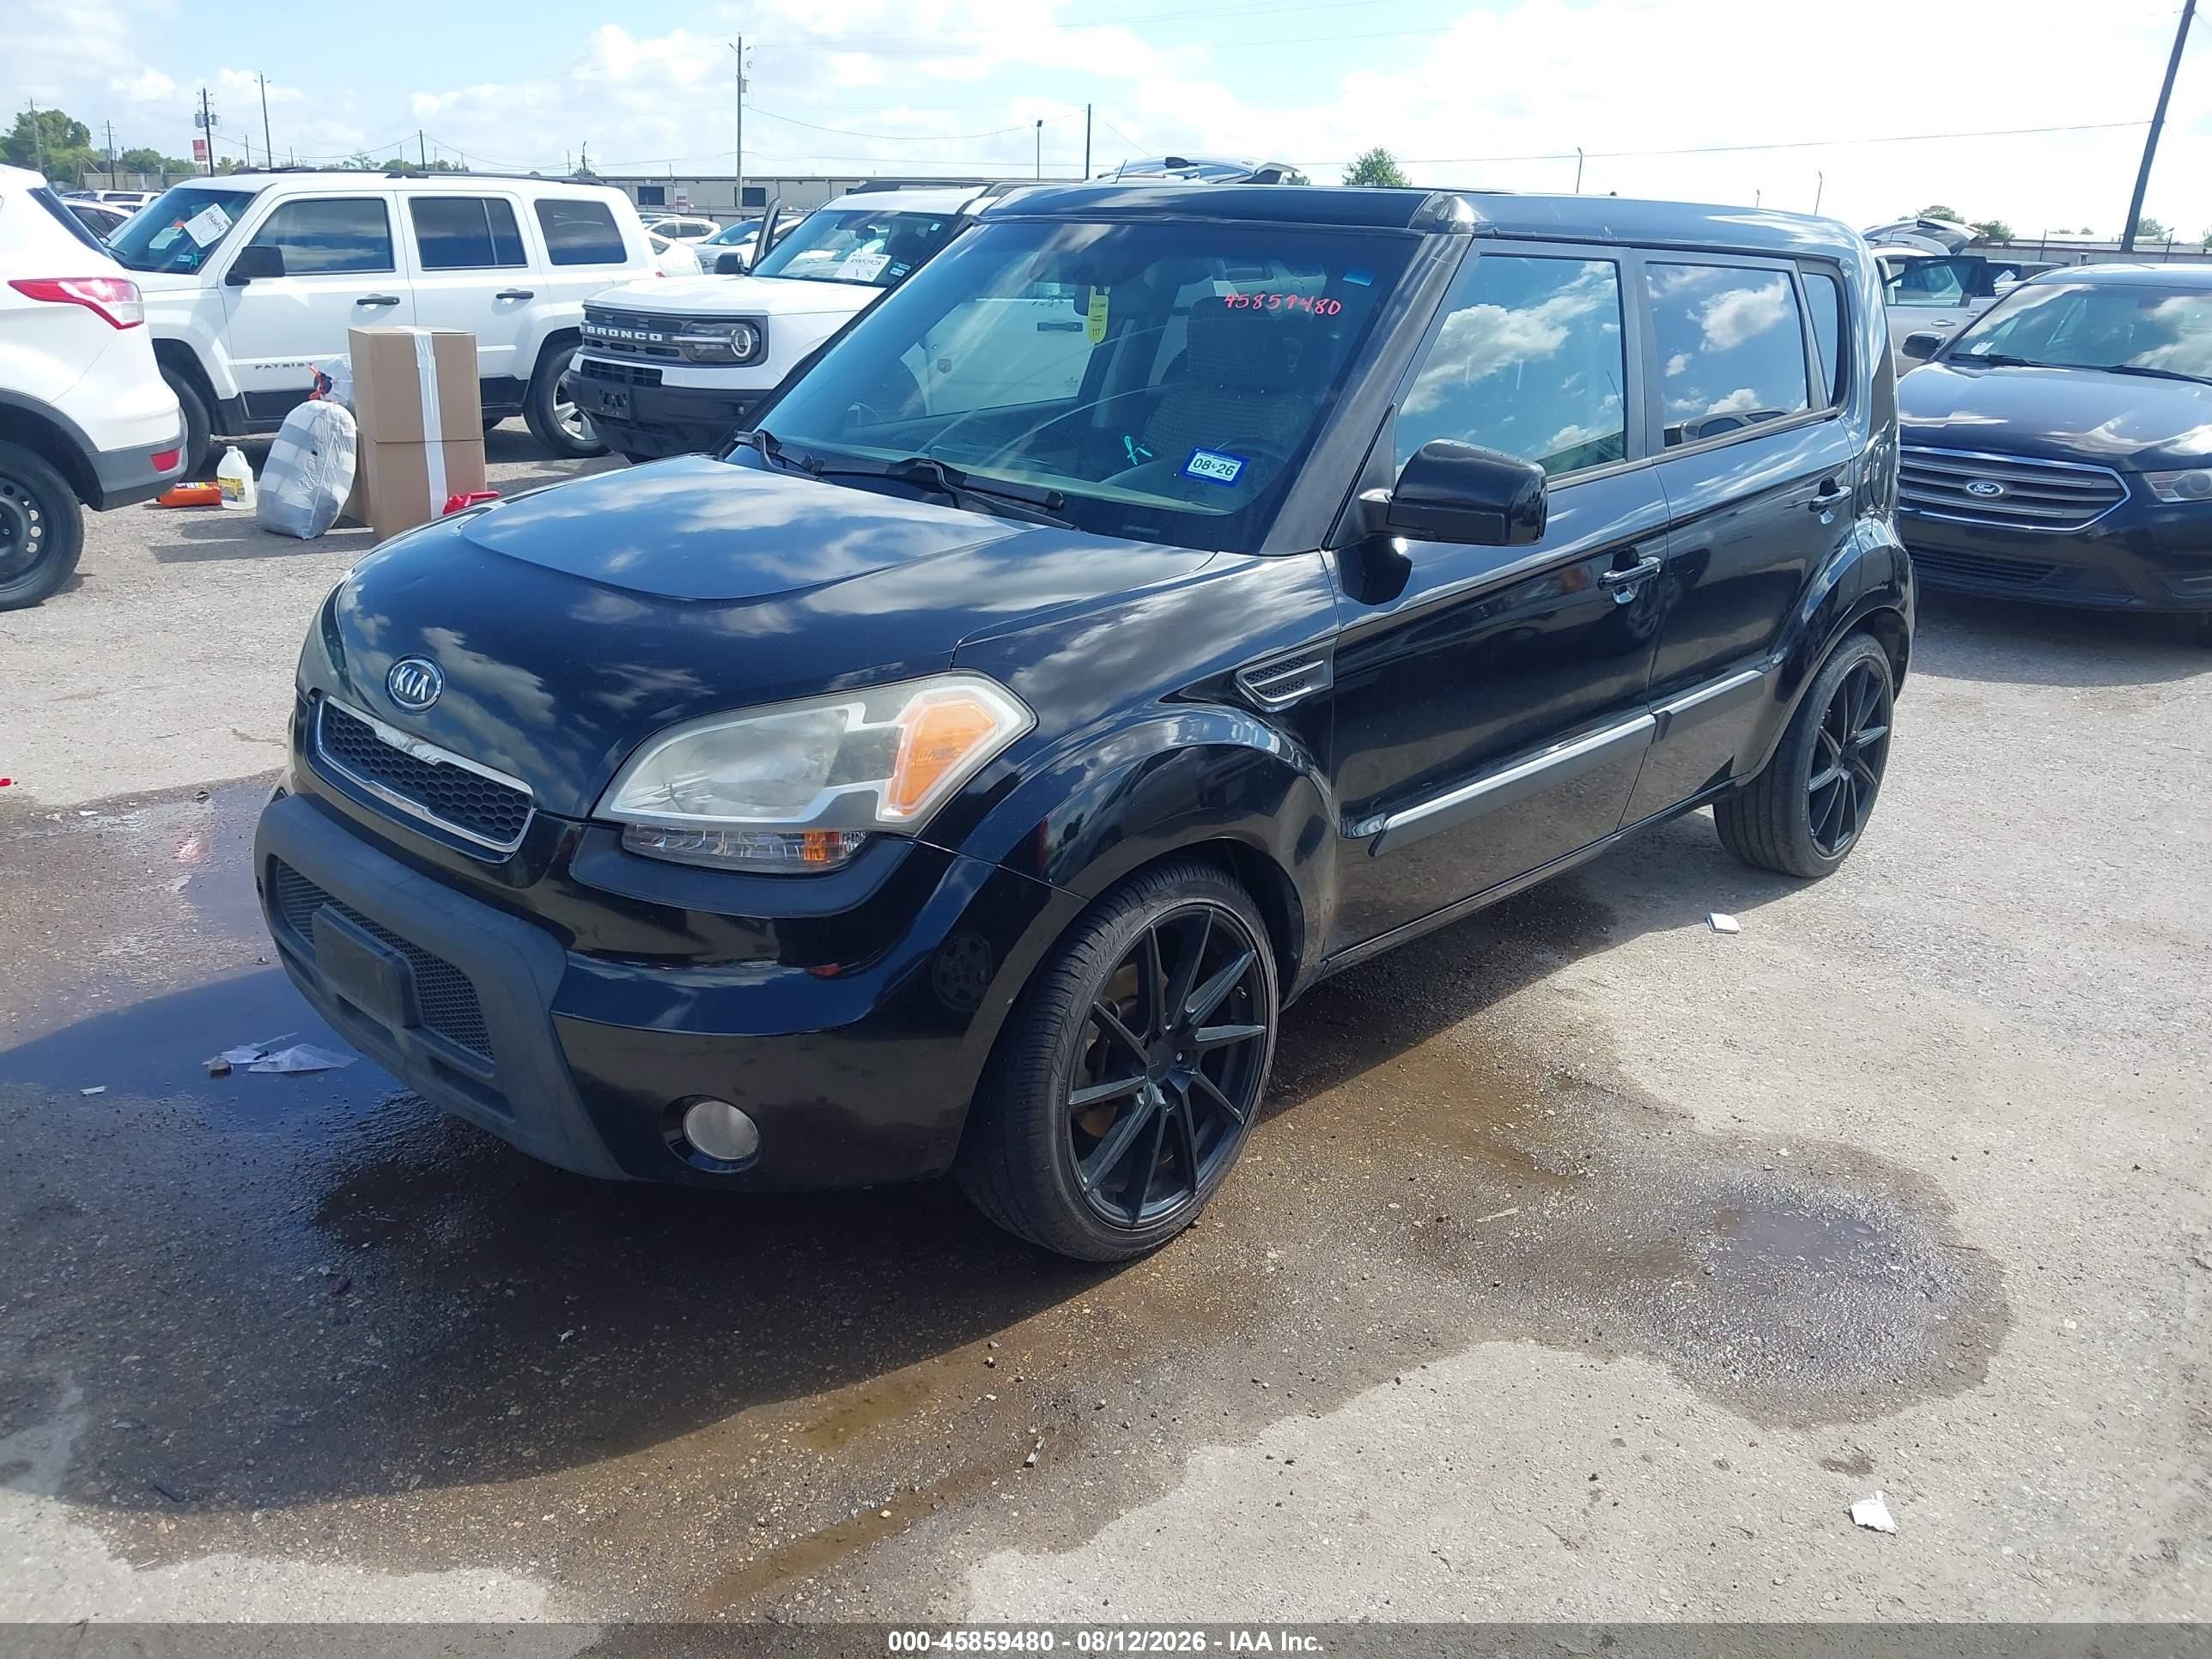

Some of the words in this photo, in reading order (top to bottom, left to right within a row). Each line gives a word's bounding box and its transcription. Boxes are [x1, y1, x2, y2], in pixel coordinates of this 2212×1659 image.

[1224, 293, 1341, 315] 45859480
[586, 325, 663, 342] BRONCO
[1092, 328, 1101, 337] 117
[255, 362, 315, 370] PATRIOT
[1194, 459, 1212, 471] 08
[1216, 464, 1236, 476] 26
[1973, 483, 1996, 494] Ford
[394, 665, 429, 701] KIA
